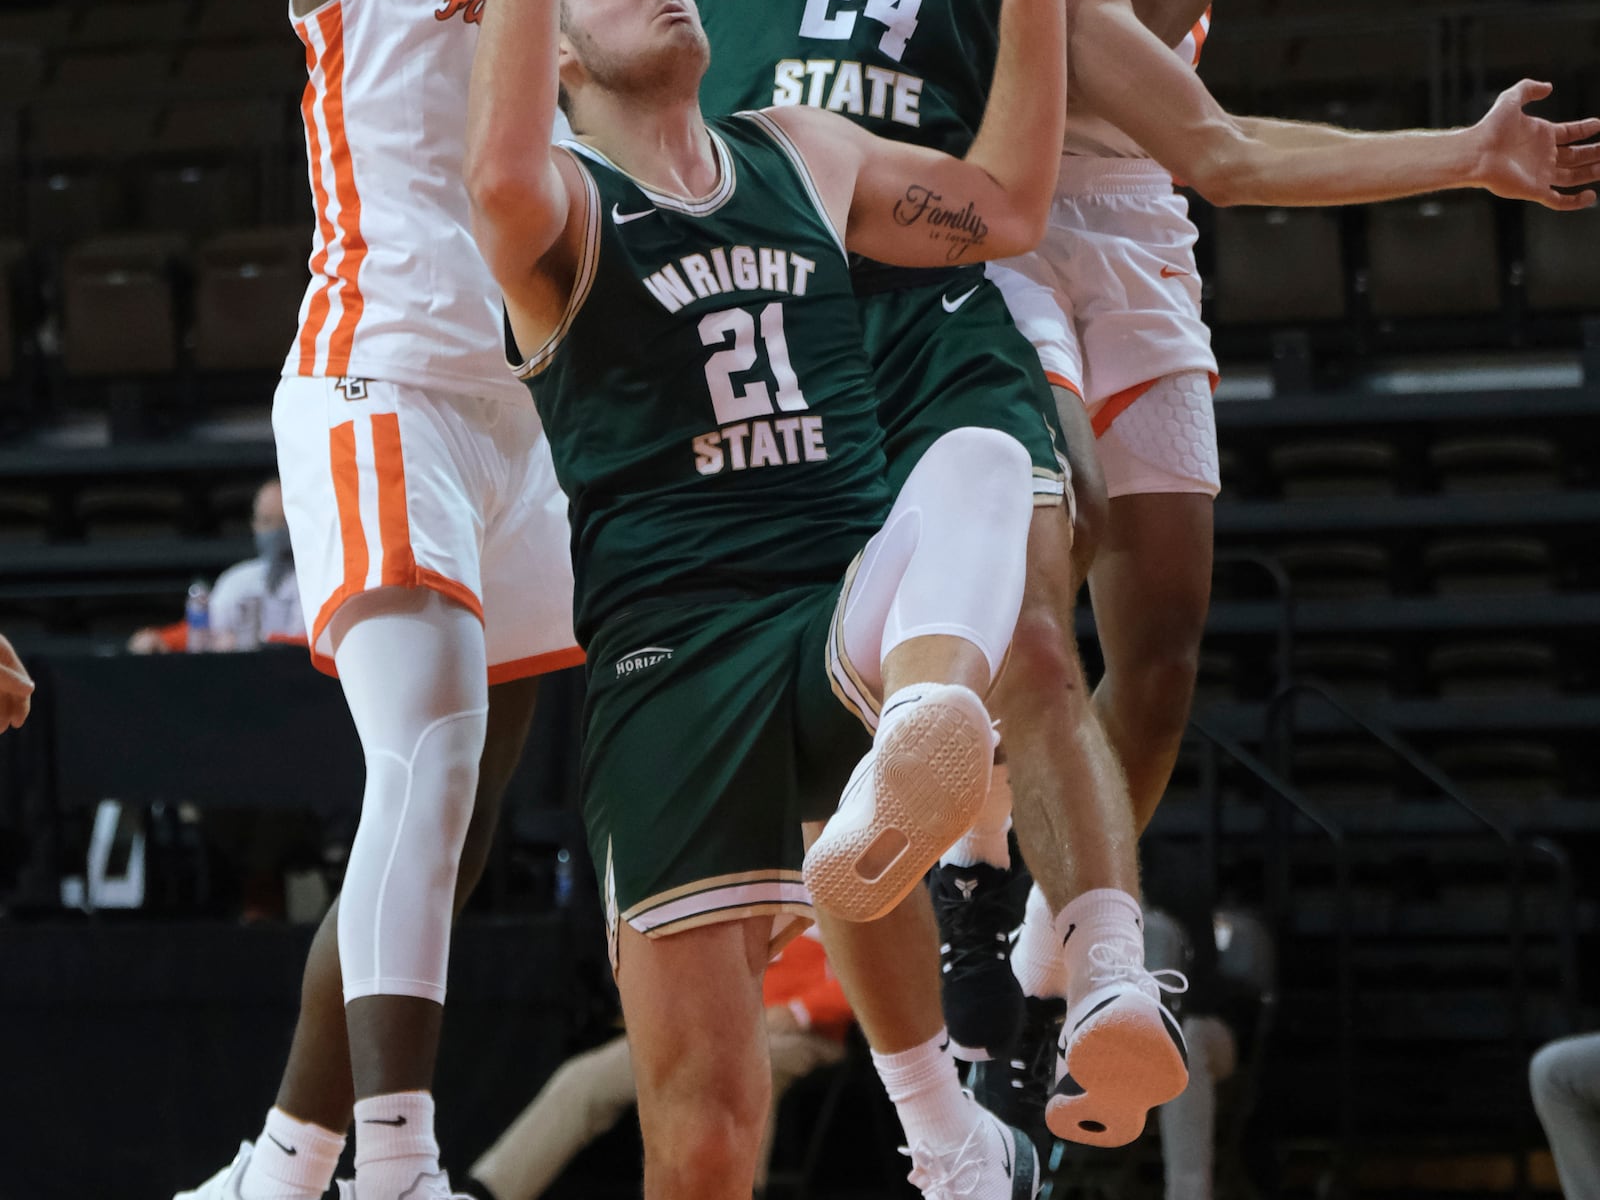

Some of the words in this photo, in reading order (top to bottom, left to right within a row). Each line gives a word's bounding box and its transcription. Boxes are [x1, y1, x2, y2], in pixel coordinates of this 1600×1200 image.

[772, 59, 924, 128] STATE
[893, 184, 988, 261] Family
[643, 245, 816, 314] WRIGHT
[697, 302, 809, 425] 21
[692, 416, 828, 475] STATE
